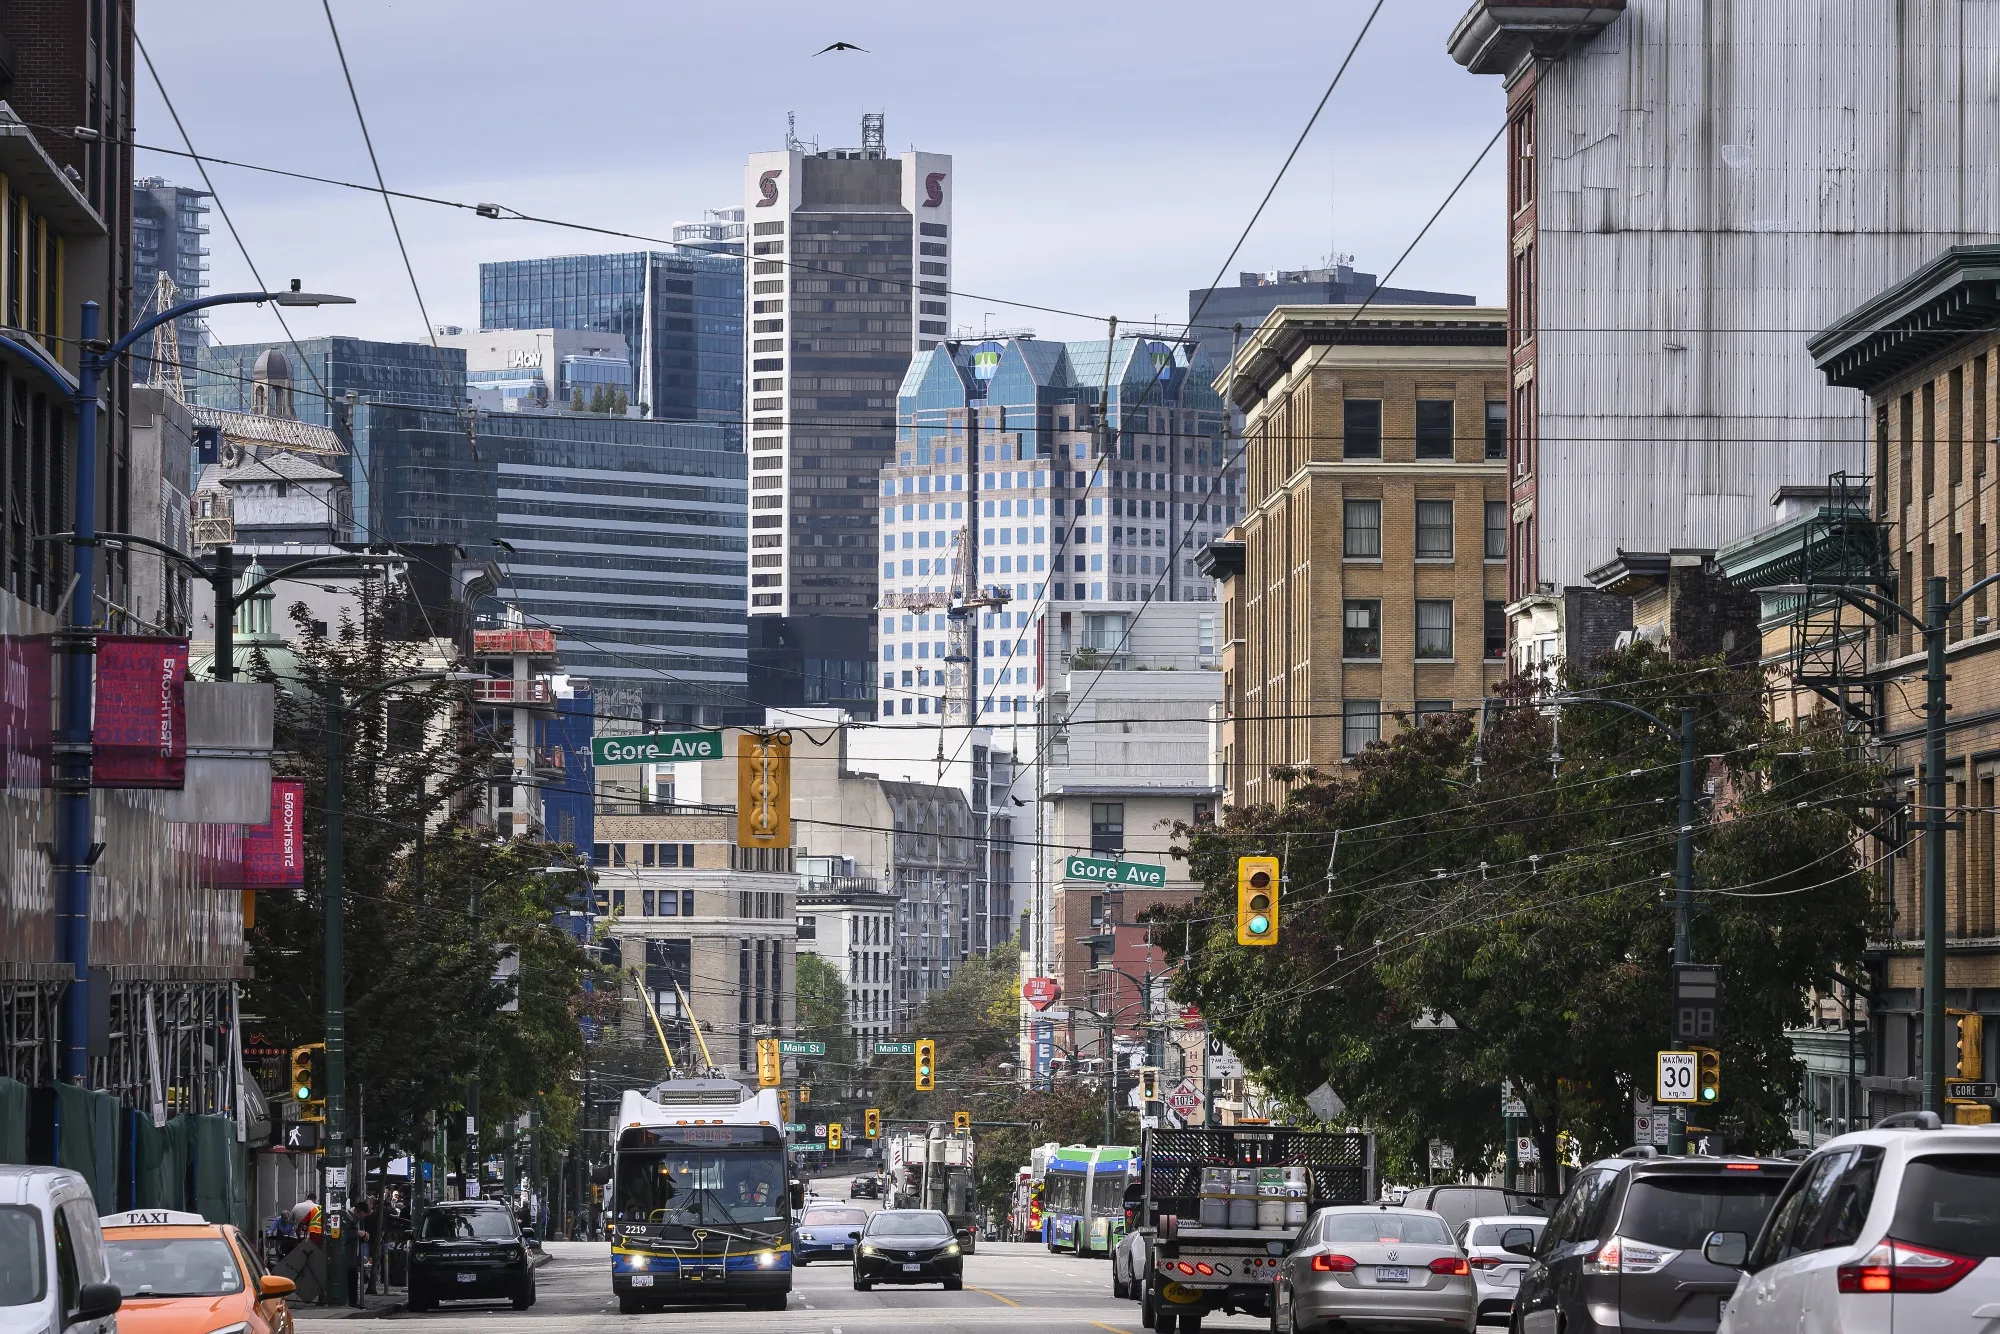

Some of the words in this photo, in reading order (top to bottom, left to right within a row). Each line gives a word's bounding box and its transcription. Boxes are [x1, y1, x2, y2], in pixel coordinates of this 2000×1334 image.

[4, 631, 29, 730] Dignity
[603, 741, 660, 761] Gore
[671, 738, 712, 757] Ave
[6, 725, 41, 822] Belonging
[11, 816, 46, 912] Justice
[1071, 860, 1117, 879] Gore
[1126, 866, 1160, 884] Ave
[783, 1043, 806, 1053] Main
[809, 1044, 820, 1053] St
[901, 1044, 911, 1052] St
[1662, 1056, 1693, 1065] MAXIMUM
[1664, 1066, 1691, 1088] 30
[1955, 1085, 1977, 1096] GORE
[1175, 1096, 1194, 1105] 1075
[684, 1129, 732, 1142] HASTINGS
[127, 1212, 169, 1224] TAXI
[625, 1225, 647, 1235] 2219
